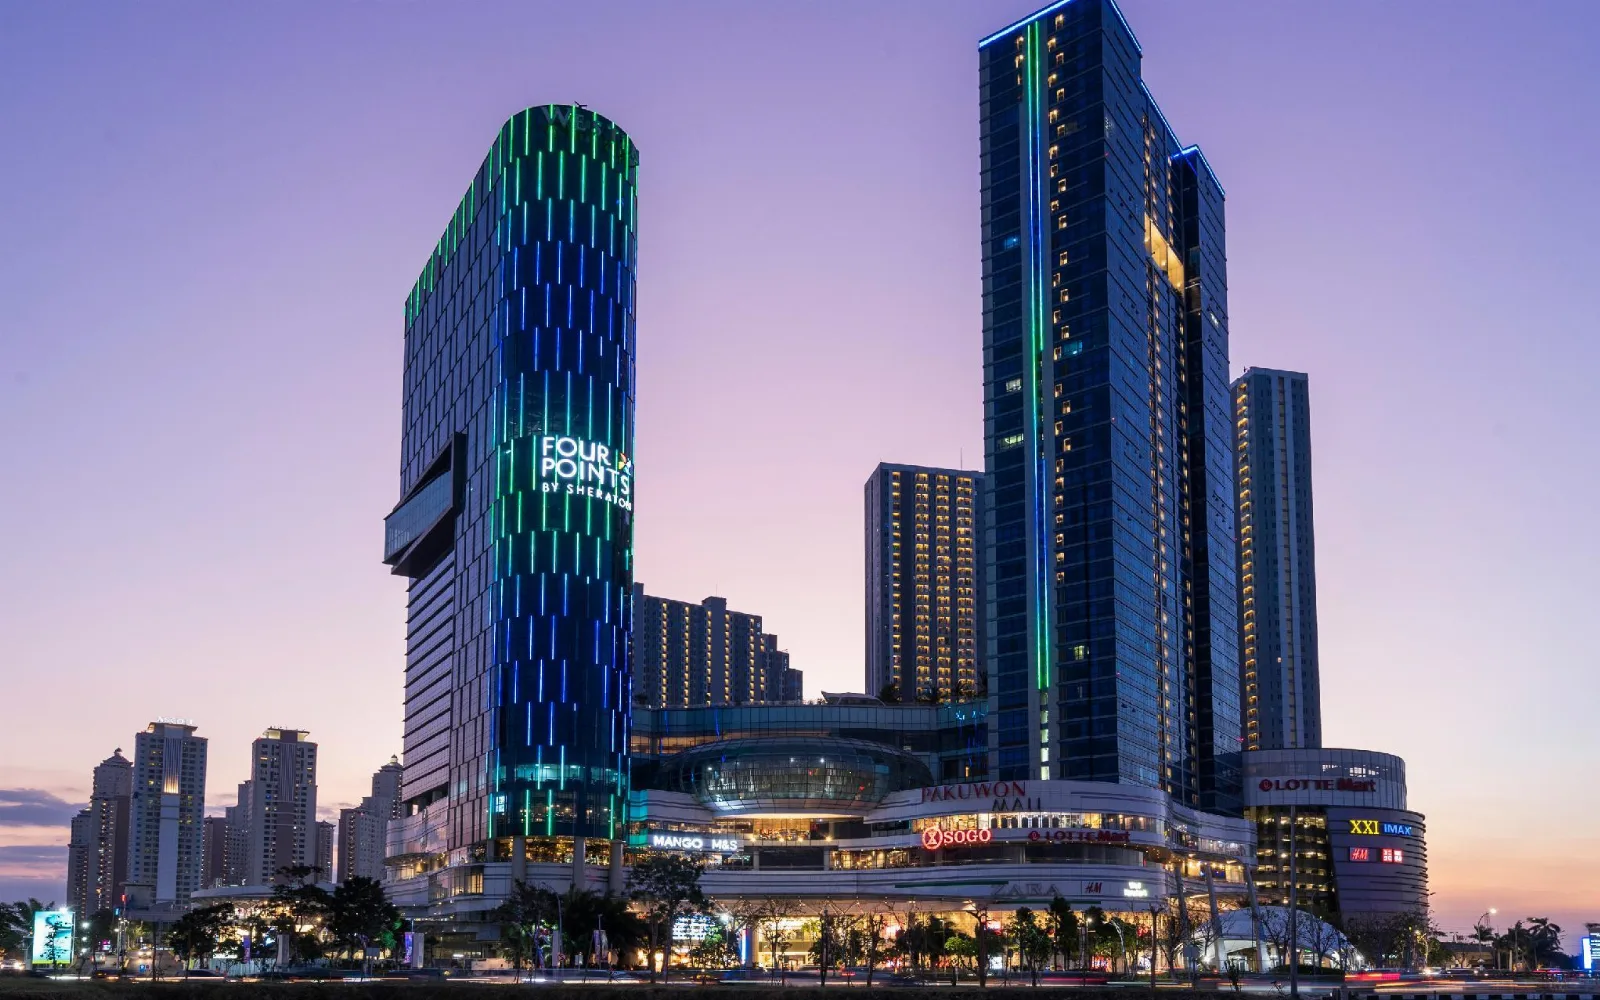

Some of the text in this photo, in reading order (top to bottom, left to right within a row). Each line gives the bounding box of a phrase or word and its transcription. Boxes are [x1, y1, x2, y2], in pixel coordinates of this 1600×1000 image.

[542, 437, 611, 466] FOUR
[542, 458, 630, 495] POINTS
[542, 482, 632, 511] BY SHERATON
[921, 781, 1026, 803] PAKUWON
[1275, 778, 1376, 792] LOTTE Mart
[943, 828, 992, 844] SOGO
[1350, 820, 1411, 836] XXI IMAX
[653, 836, 703, 849] MANGO
[711, 839, 738, 850] M&S
[991, 882, 1061, 897] ZARA
